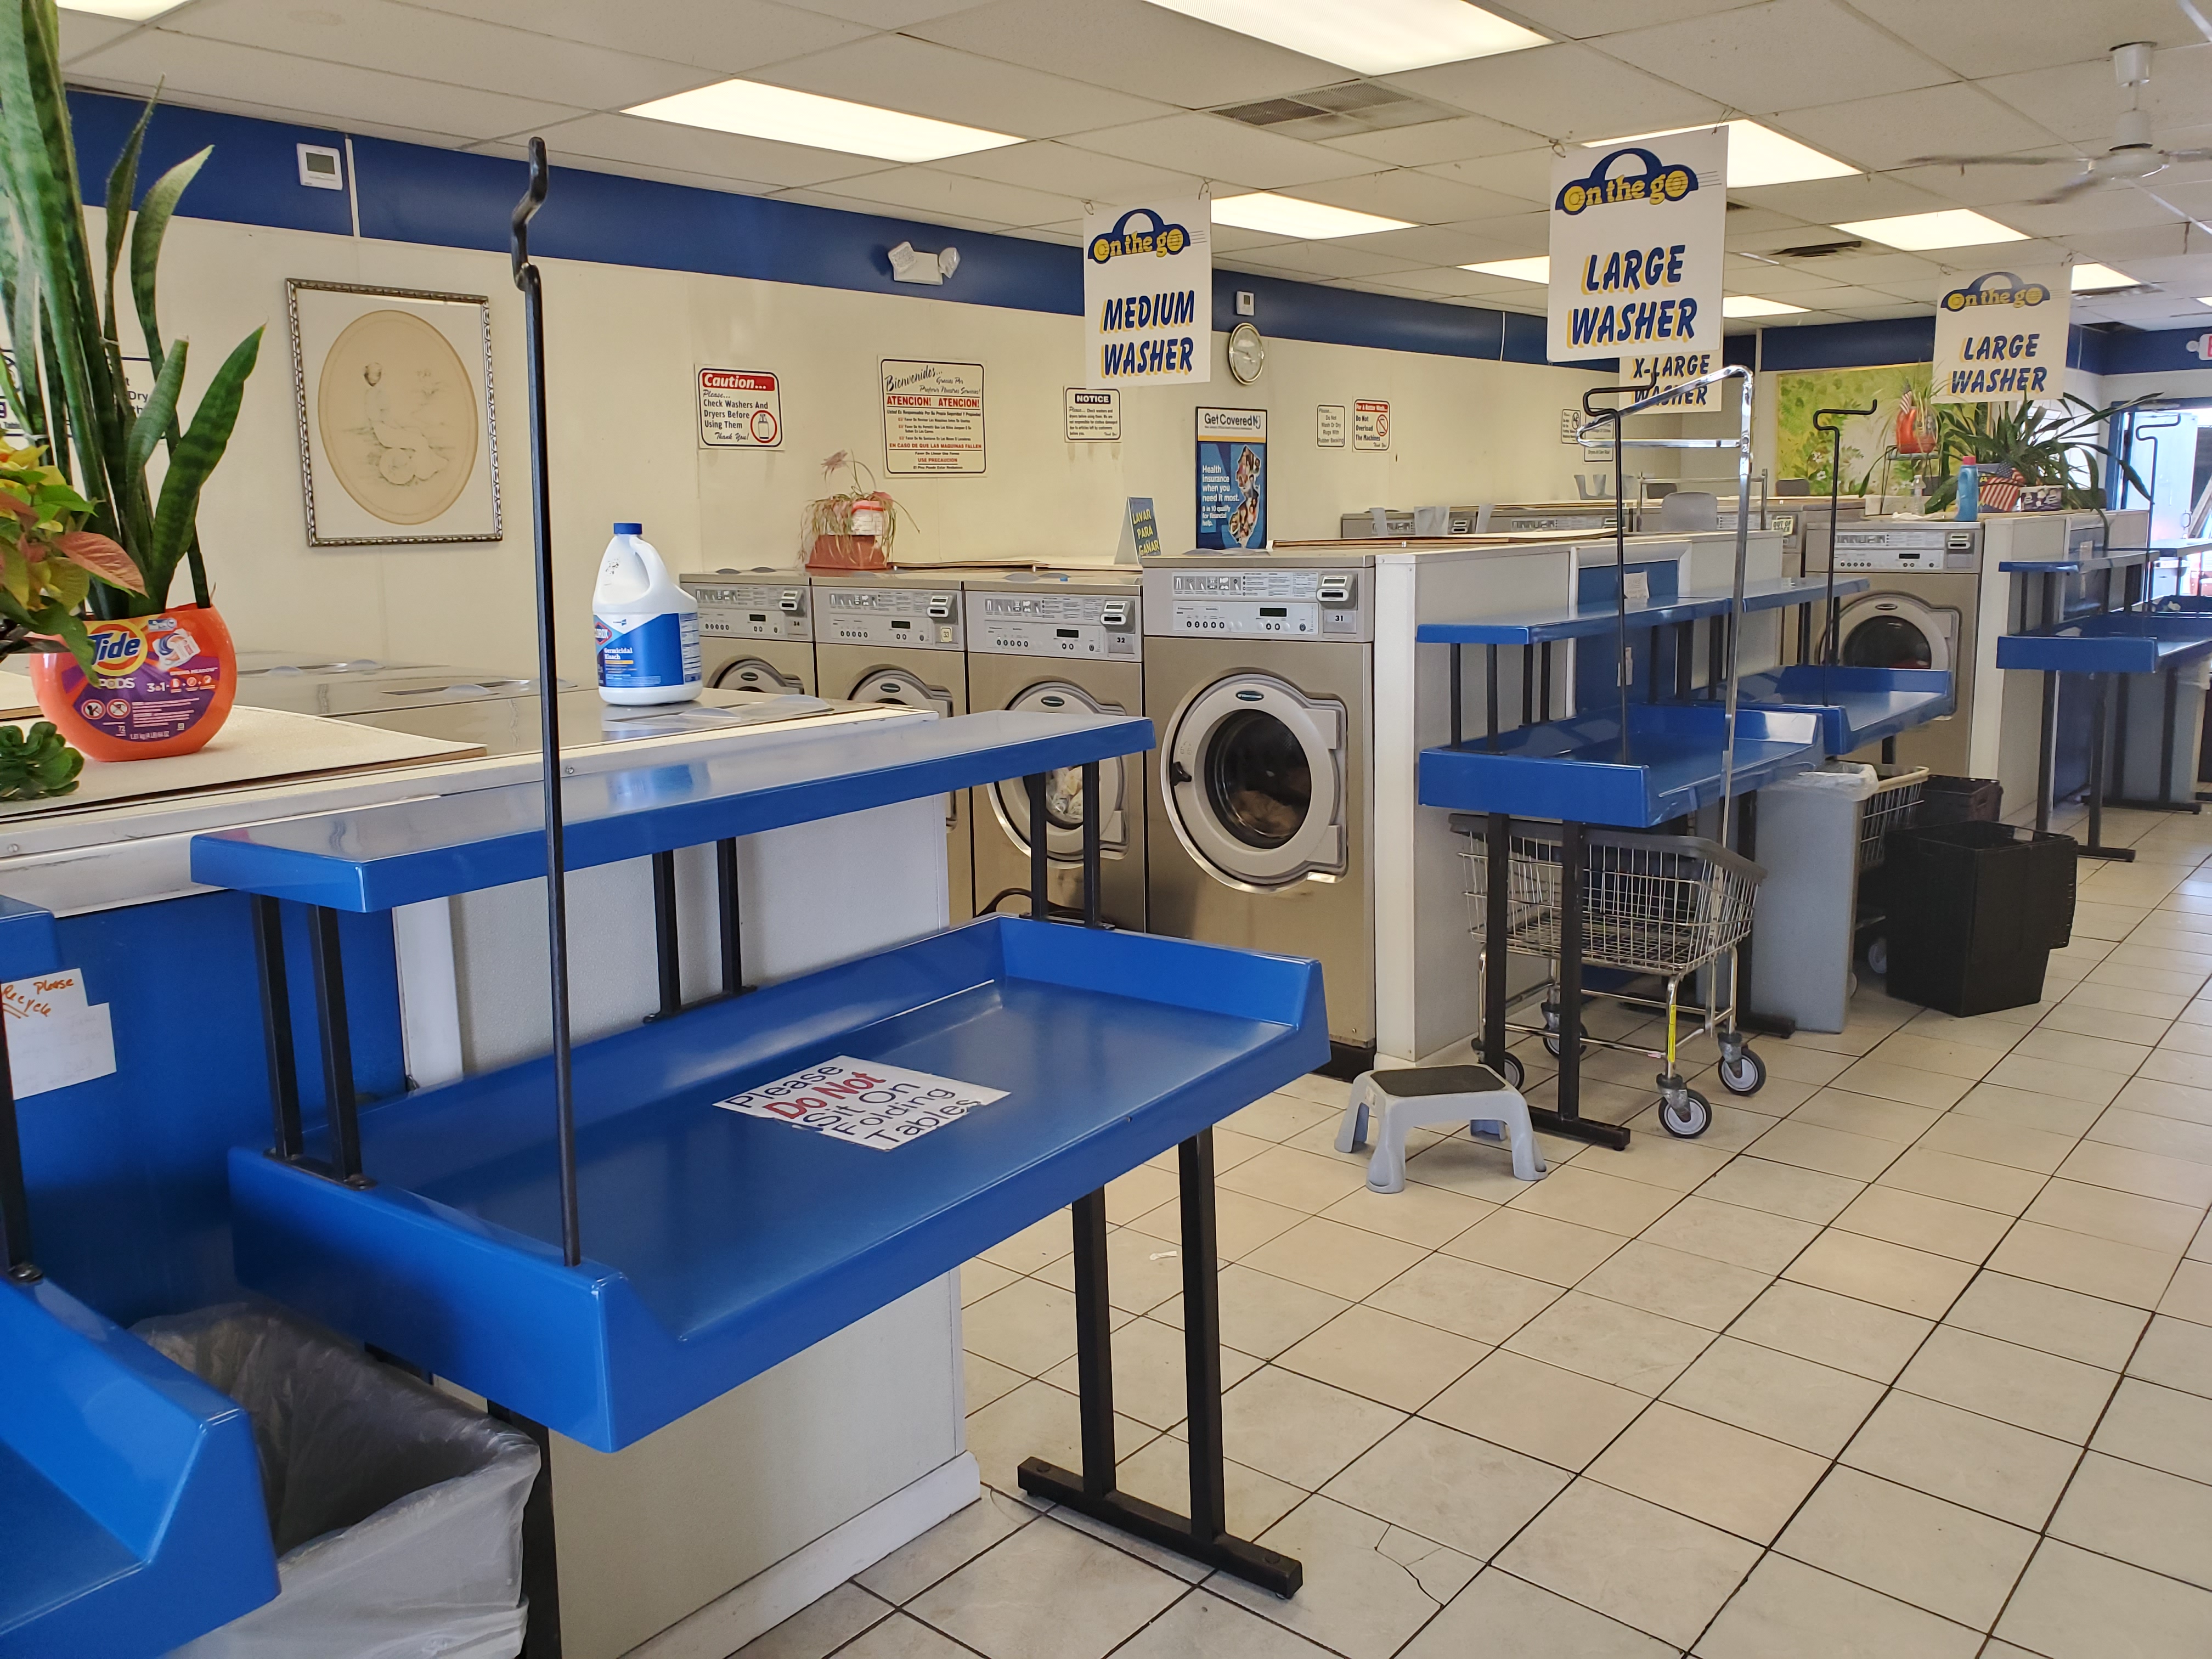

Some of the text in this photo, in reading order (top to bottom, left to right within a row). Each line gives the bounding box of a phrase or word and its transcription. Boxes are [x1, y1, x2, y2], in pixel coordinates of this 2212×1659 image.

[1564, 170, 1689, 212] On the go
[1093, 229, 1183, 261] On the go
[1584, 245, 1685, 293] LARGE
[1948, 287, 2042, 309] On the go
[1101, 290, 1194, 332] MEDIUM
[1569, 298, 1697, 347] WASHER
[1102, 337, 1194, 377] WASHER
[1960, 334, 2040, 362] LARGE
[1632, 354, 1710, 379] X-LARGE
[704, 374, 766, 389] Caution...
[1949, 367, 2047, 394] WASHER
[703, 390, 730, 398] Please...
[725, 400, 753, 409] Washers
[887, 396, 979, 408] ATENCION! ATENCION!
[704, 410, 725, 419] Dryers
[704, 420, 723, 430] Using
[735, 433, 749, 442] You!
[1202, 465, 1222, 473] Health
[1203, 484, 1218, 492] when
[1132, 509, 1152, 524] LAVAR
[1137, 525, 1153, 540] PARA
[1138, 540, 1160, 556] GANAR
[88, 632, 140, 665] Tide
[99, 678, 135, 689] PODS
[725, 1065, 843, 1108] Please
[761, 1071, 887, 1120] Do Not
[803, 1083, 921, 1127] Sit On
[833, 1088, 956, 1136] Folding
[864, 1098, 981, 1143] Tables
